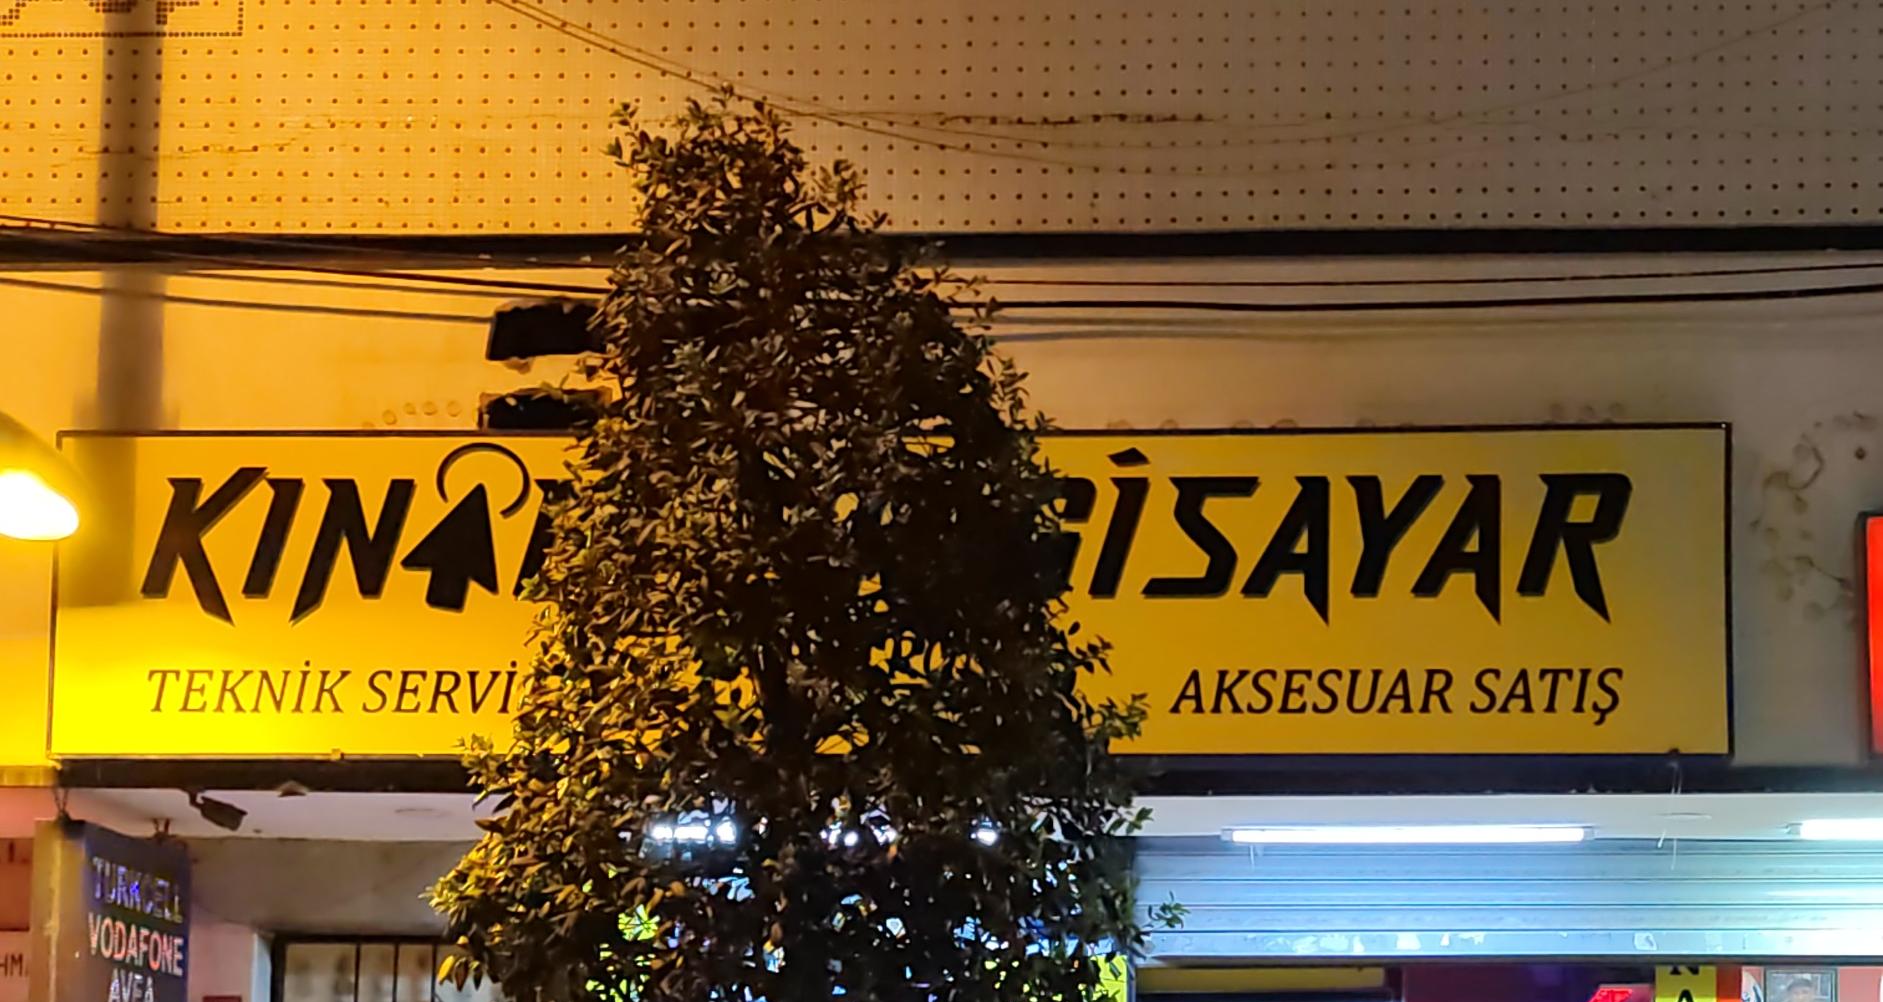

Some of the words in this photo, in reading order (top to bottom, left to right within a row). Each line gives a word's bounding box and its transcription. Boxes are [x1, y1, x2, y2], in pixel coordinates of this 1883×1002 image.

[148, 660, 352, 713] TEKNİK
[362, 660, 518, 713] SERVİ
[1169, 667, 1453, 715] AKSESUAR
[1470, 667, 1623, 725] SATIŞ
[88, 912, 184, 976] VODAFONE
